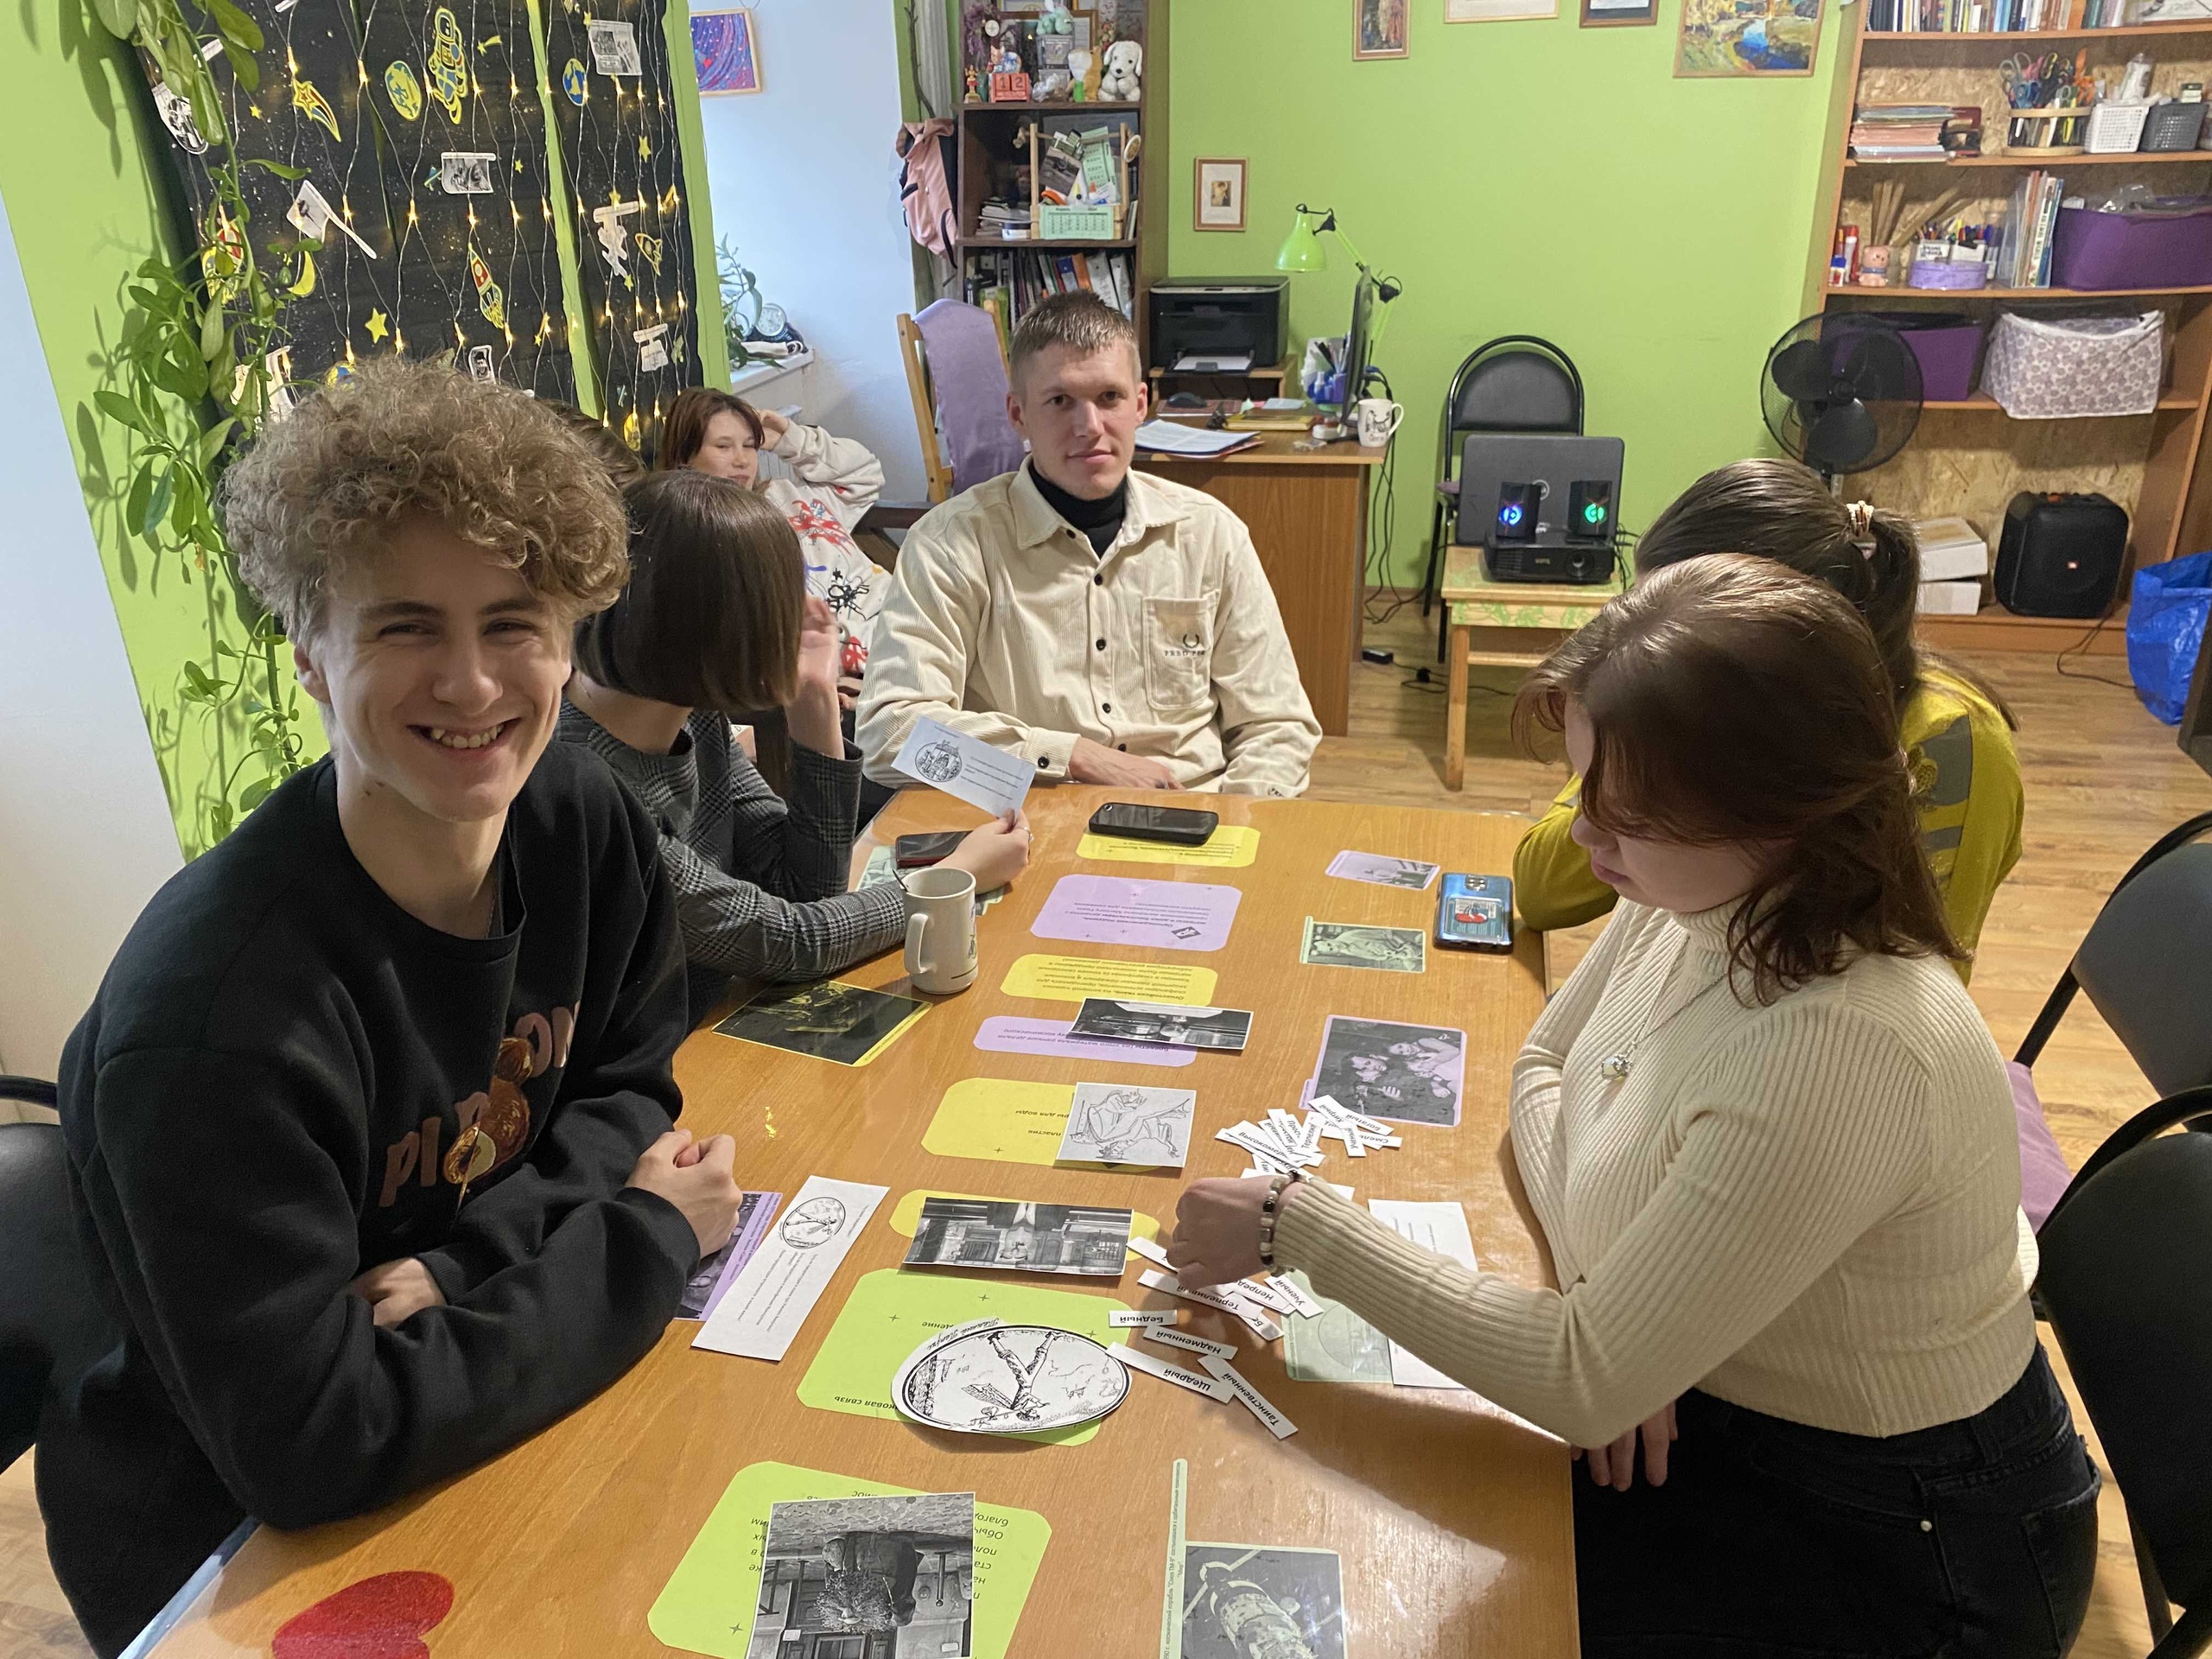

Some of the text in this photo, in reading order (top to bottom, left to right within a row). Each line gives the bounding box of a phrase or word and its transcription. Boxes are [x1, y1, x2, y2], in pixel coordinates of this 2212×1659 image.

[1015, 76, 1023, 88] 2
[1345, 1114, 1381, 1131] Богатый
[1274, 1279, 1306, 1306] Ученый
[1120, 1315, 1164, 1324] Бедный
[1156, 1330, 1221, 1354] Надменный
[1164, 1369, 1211, 1391] Щедрый
[834, 1395, 861, 1407] связь
[1224, 1372, 1280, 1427] Таинственный
[974, 1526, 1004, 1540] Обыч
